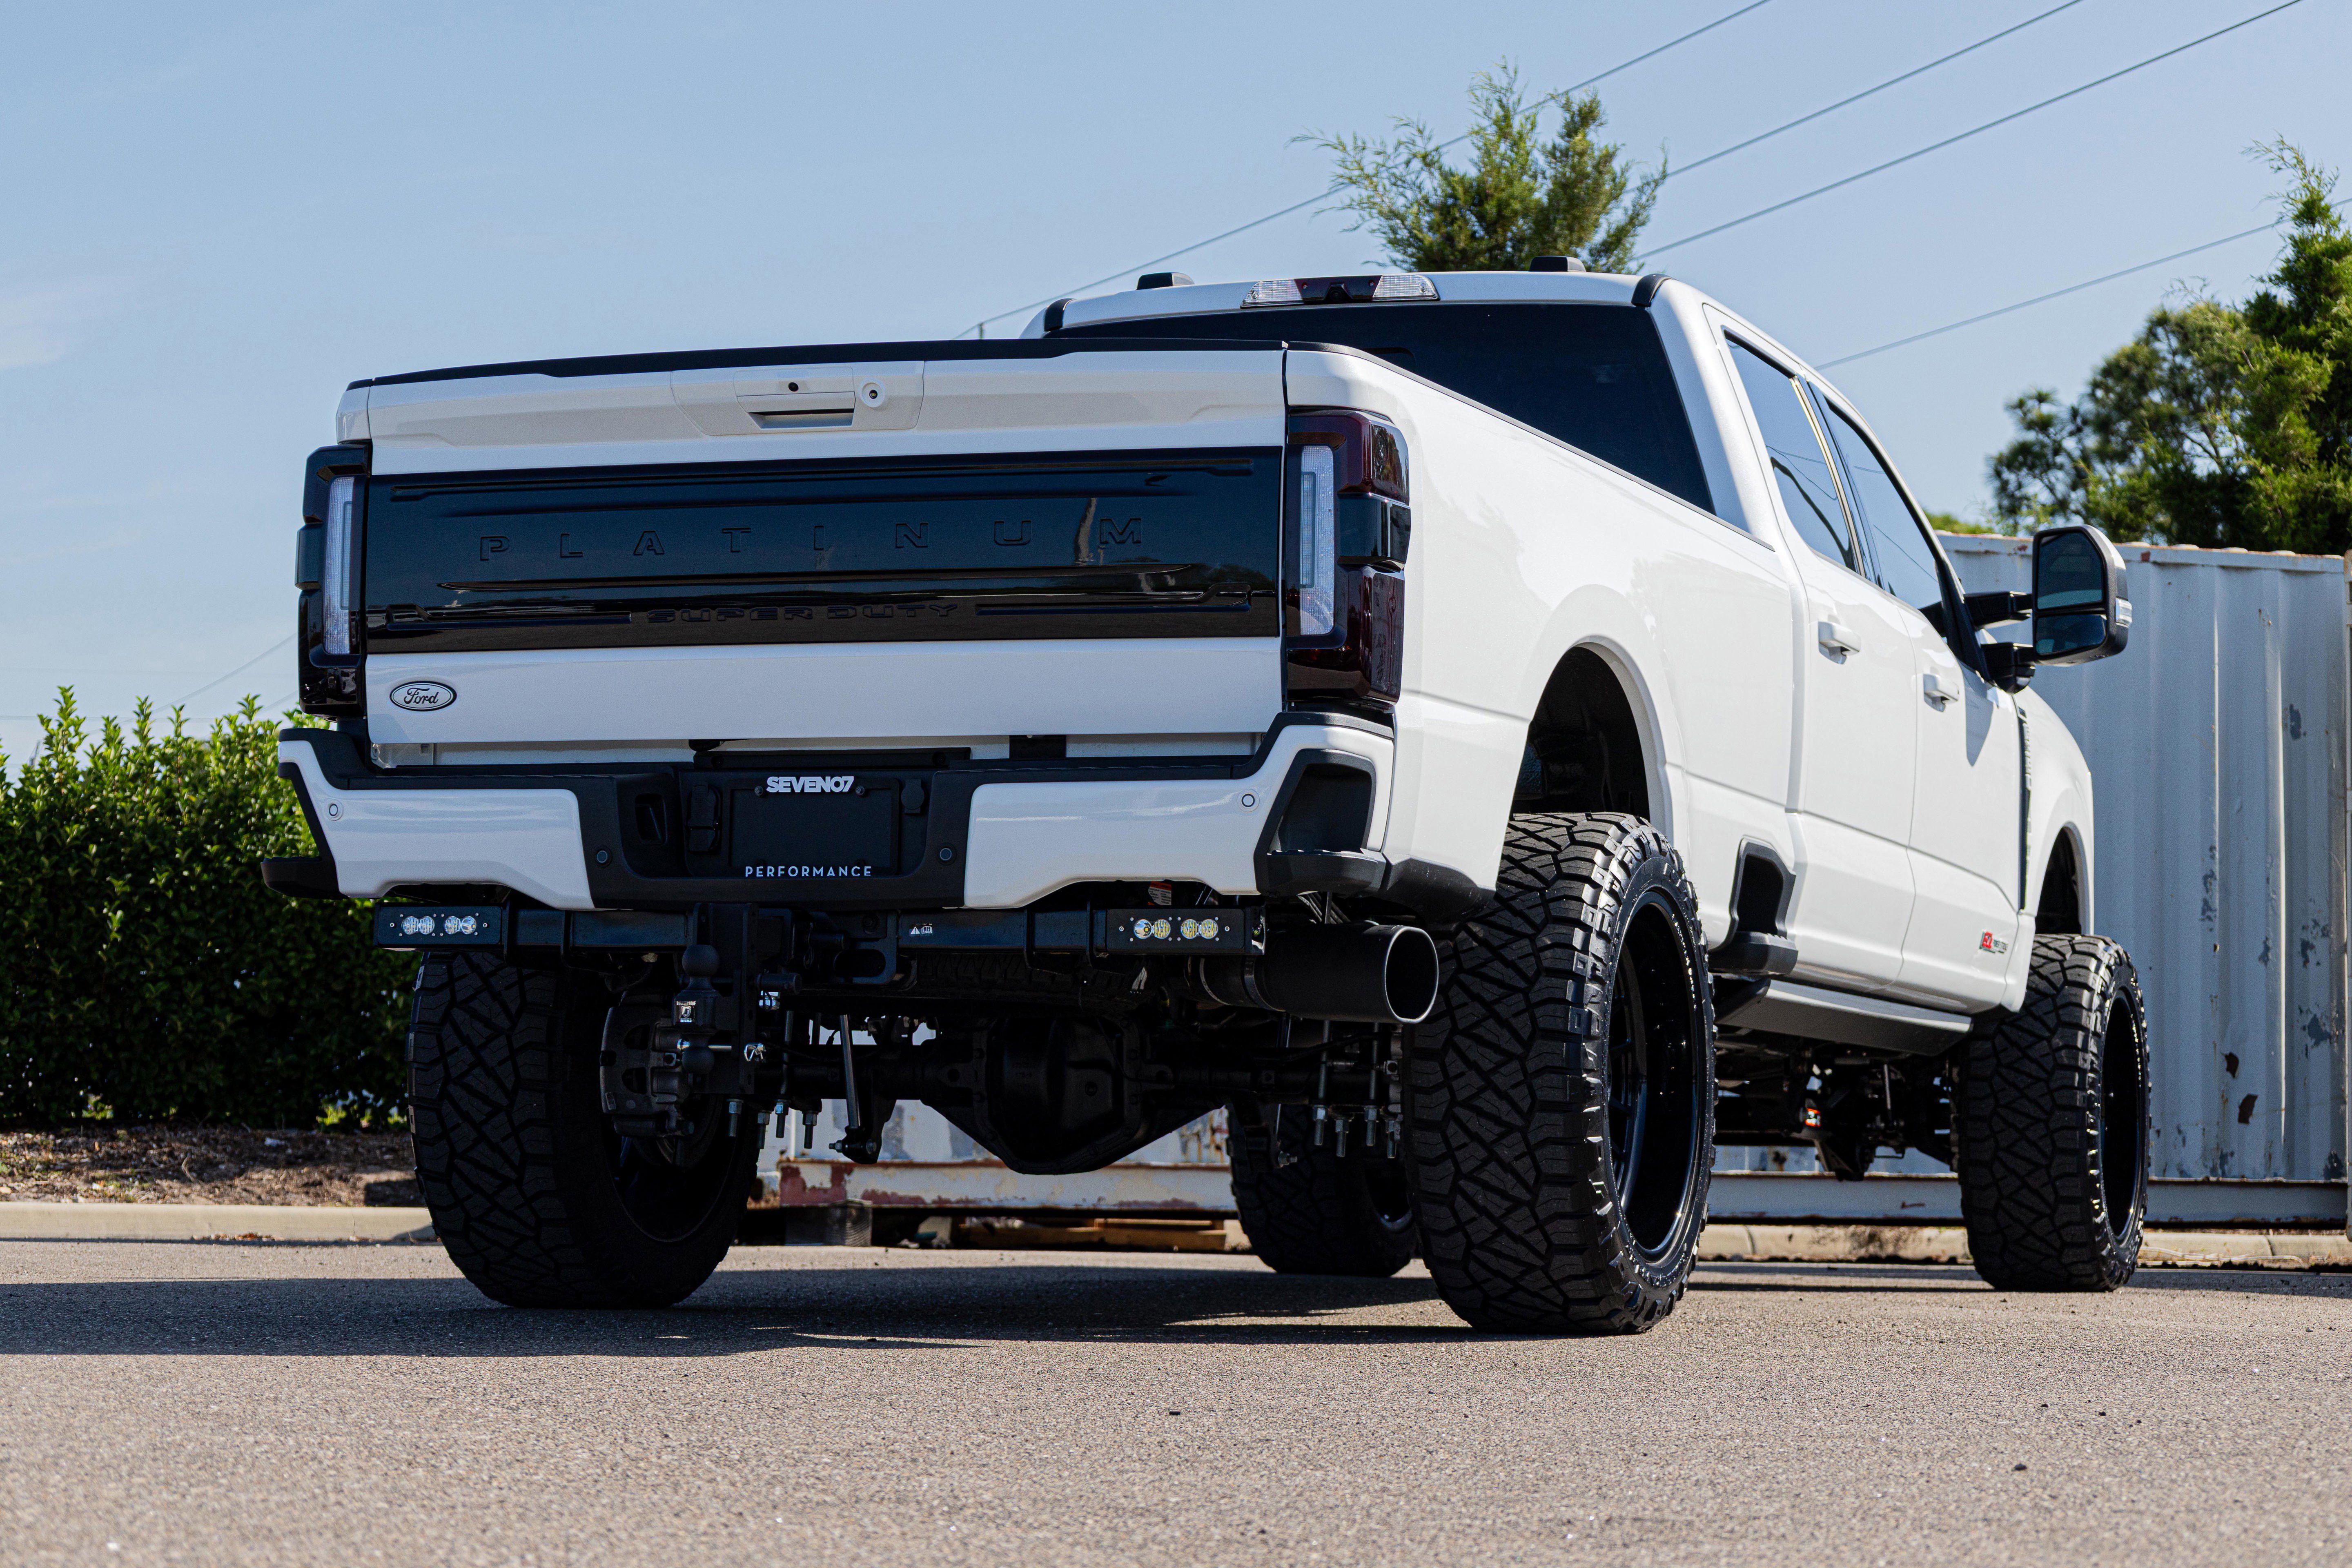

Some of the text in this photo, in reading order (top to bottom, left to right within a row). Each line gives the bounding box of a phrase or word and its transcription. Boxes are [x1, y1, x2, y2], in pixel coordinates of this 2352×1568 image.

[479, 517, 1142, 561] PLATINUM
[646, 604, 958, 623] SUPER DUTY
[403, 687, 439, 704] Ford
[745, 866, 872, 877] PERFORMANCE
